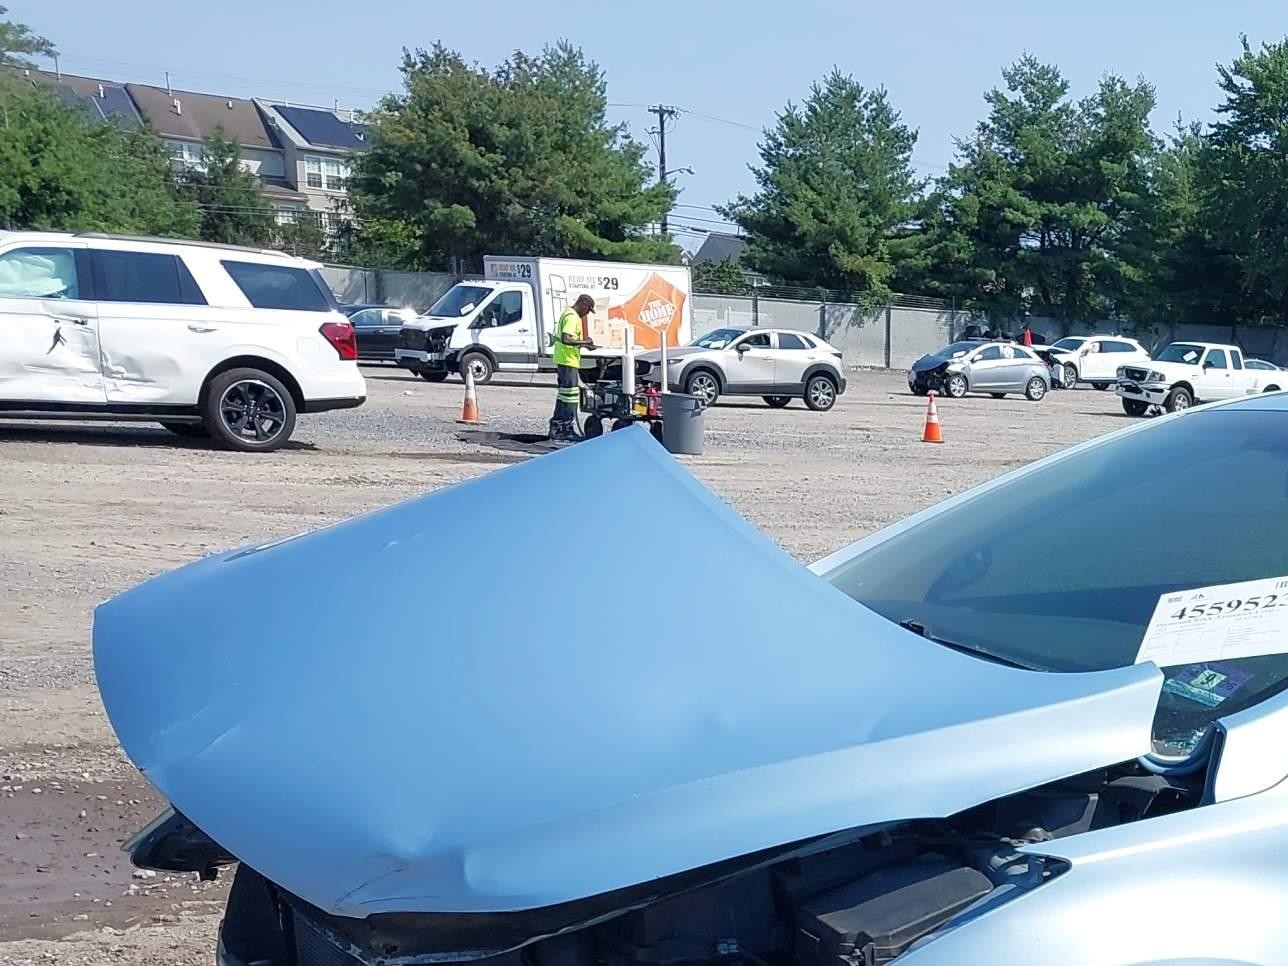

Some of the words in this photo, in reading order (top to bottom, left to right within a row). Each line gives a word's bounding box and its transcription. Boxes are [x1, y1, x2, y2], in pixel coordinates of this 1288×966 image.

[517, 264, 531, 278] $29
[598, 277, 619, 290] $29
[640, 303, 674, 321] HOME
